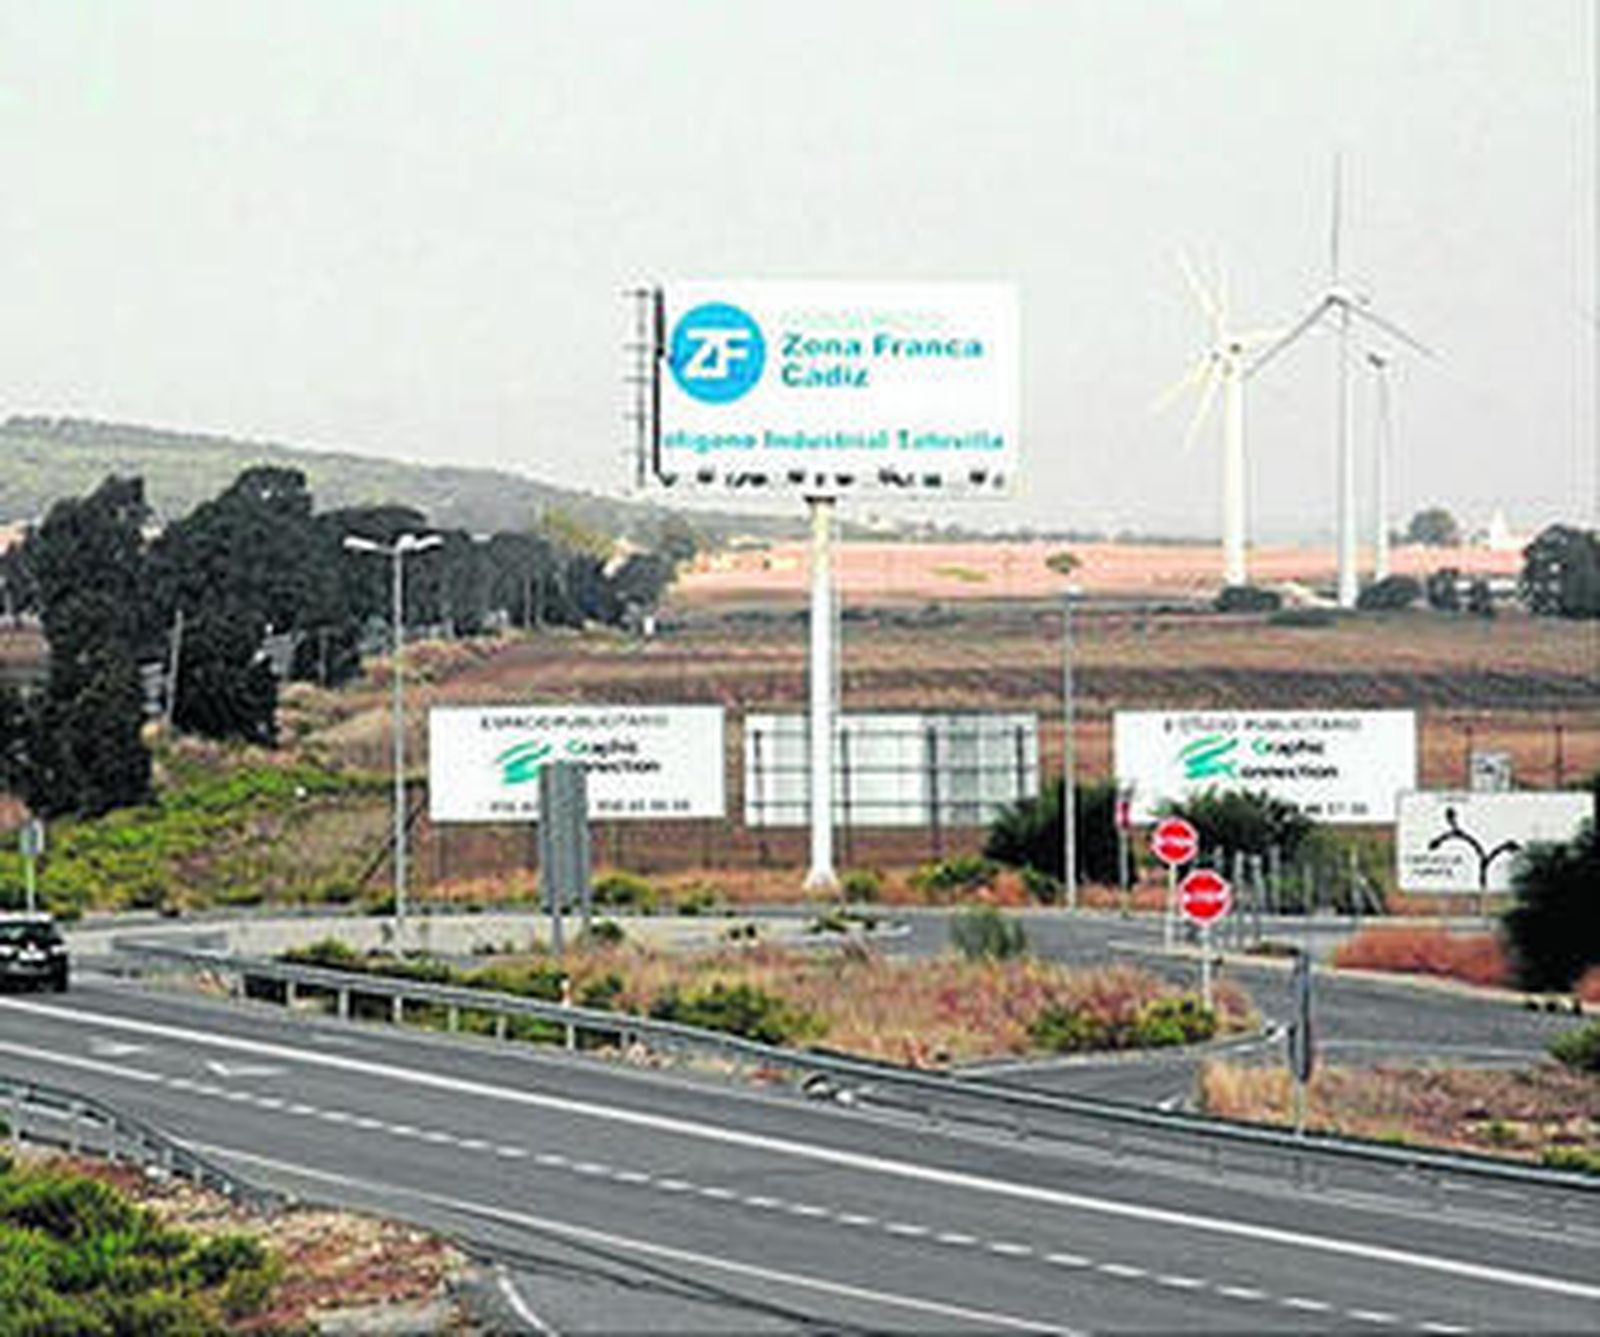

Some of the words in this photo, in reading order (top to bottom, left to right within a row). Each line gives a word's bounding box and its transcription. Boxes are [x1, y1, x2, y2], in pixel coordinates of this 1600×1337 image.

[684, 328, 751, 380] ZF
[781, 333, 862, 359] Zona
[873, 333, 984, 359] Franca
